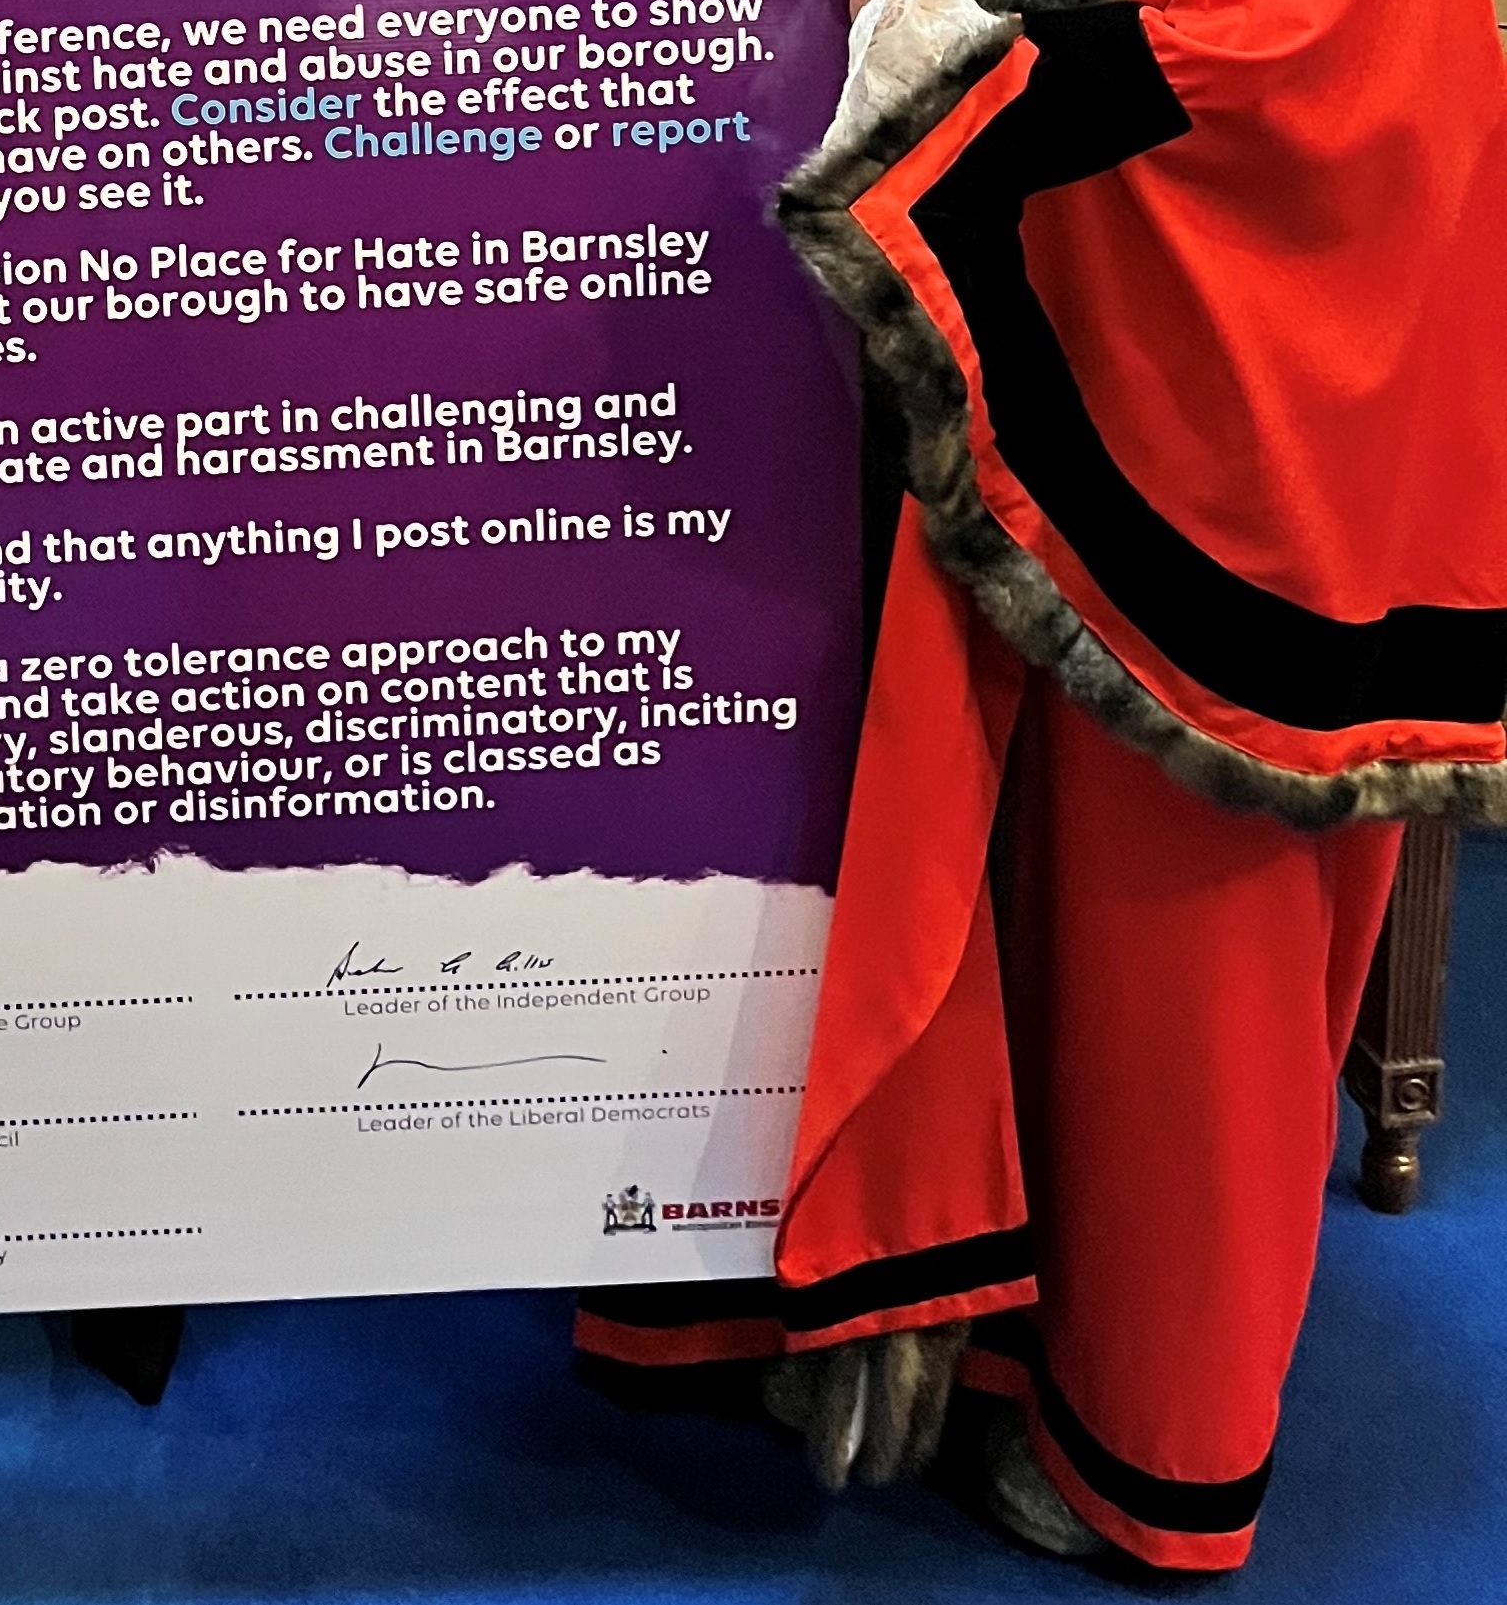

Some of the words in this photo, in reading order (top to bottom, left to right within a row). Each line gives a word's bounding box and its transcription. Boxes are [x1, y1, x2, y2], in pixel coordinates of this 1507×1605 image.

[182, 18, 247, 47] we
[258, 3, 365, 44] need
[376, 3, 581, 44] everyone
[92, 55, 193, 90] hate
[203, 47, 287, 86] and
[299, 45, 432, 82] abuse
[443, 40, 481, 75] in
[492, 44, 566, 73] our
[578, 27, 775, 73] borough.
[53, 97, 160, 141] post.
[171, 86, 362, 126] Consider
[372, 81, 447, 118] the
[457, 76, 590, 115] effect
[599, 72, 696, 108] that
[97, 142, 150, 170] on
[162, 129, 313, 167] others.
[324, 121, 543, 162] Challenge
[554, 122, 600, 150] or
[612, 111, 751, 154] report
[78, 181, 151, 210] see
[162, 171, 204, 206] it.
[79, 248, 139, 282] No
[150, 243, 267, 279] Place
[277, 238, 342, 274] for
[354, 237, 460, 271] Hate
[471, 231, 509, 266] in
[522, 223, 710, 265] Barnsley
[22, 295, 94, 324] our
[106, 278, 288, 324] borough
[299, 280, 346, 312] to
[357, 274, 464, 309] have
[474, 266, 569, 305] safe
[579, 262, 712, 300] online
[31, 407, 165, 444] active
[176, 404, 271, 451] part
[281, 399, 319, 433] in
[330, 389, 582, 437] challenging
[594, 382, 676, 420] and
[81, 442, 163, 481] and
[176, 435, 435, 476] harassment
[446, 430, 483, 464] in
[495, 422, 693, 464] Barnsley.
[42, 528, 137, 564] that
[147, 519, 339, 566] anything
[352, 518, 362, 550] I
[375, 515, 470, 558] post
[480, 507, 611, 545] online
[623, 504, 655, 538] is
[668, 508, 732, 543] my
[20, 654, 113, 682] zero
[123, 642, 331, 678] tolerance
[341, 626, 548, 675] approach
[559, 629, 605, 658] to
[617, 629, 681, 665] my
[60, 682, 160, 717] take
[171, 676, 305, 713] action
[317, 680, 369, 706] on
[380, 667, 547, 704] content
[556, 661, 651, 695] that
[662, 665, 694, 690] is
[49, 717, 293, 755] slanderous,
[305, 704, 627, 744] discriminatory,
[640, 691, 797, 730] inciting
[107, 750, 333, 789] behaviour,
[344, 753, 389, 779] or
[400, 743, 432, 776] is
[443, 731, 602, 774] classed
[613, 740, 661, 766] as
[113, 799, 158, 825] or
[169, 779, 496, 823] disinformation.
[14, 1013, 82, 1033] Group
[344, 997, 421, 1016] Leader
[427, 994, 449, 1013] of
[455, 994, 491, 1012] the
[497, 988, 636, 1011] Independent
[643, 986, 711, 1006] Group
[357, 1114, 435, 1133] Leader
[440, 1111, 461, 1130] of
[468, 1110, 503, 1129] the
[509, 1107, 585, 1127] Liberal
[591, 1104, 710, 1123] Democrats
[661, 1199, 782, 1220] BARNS
